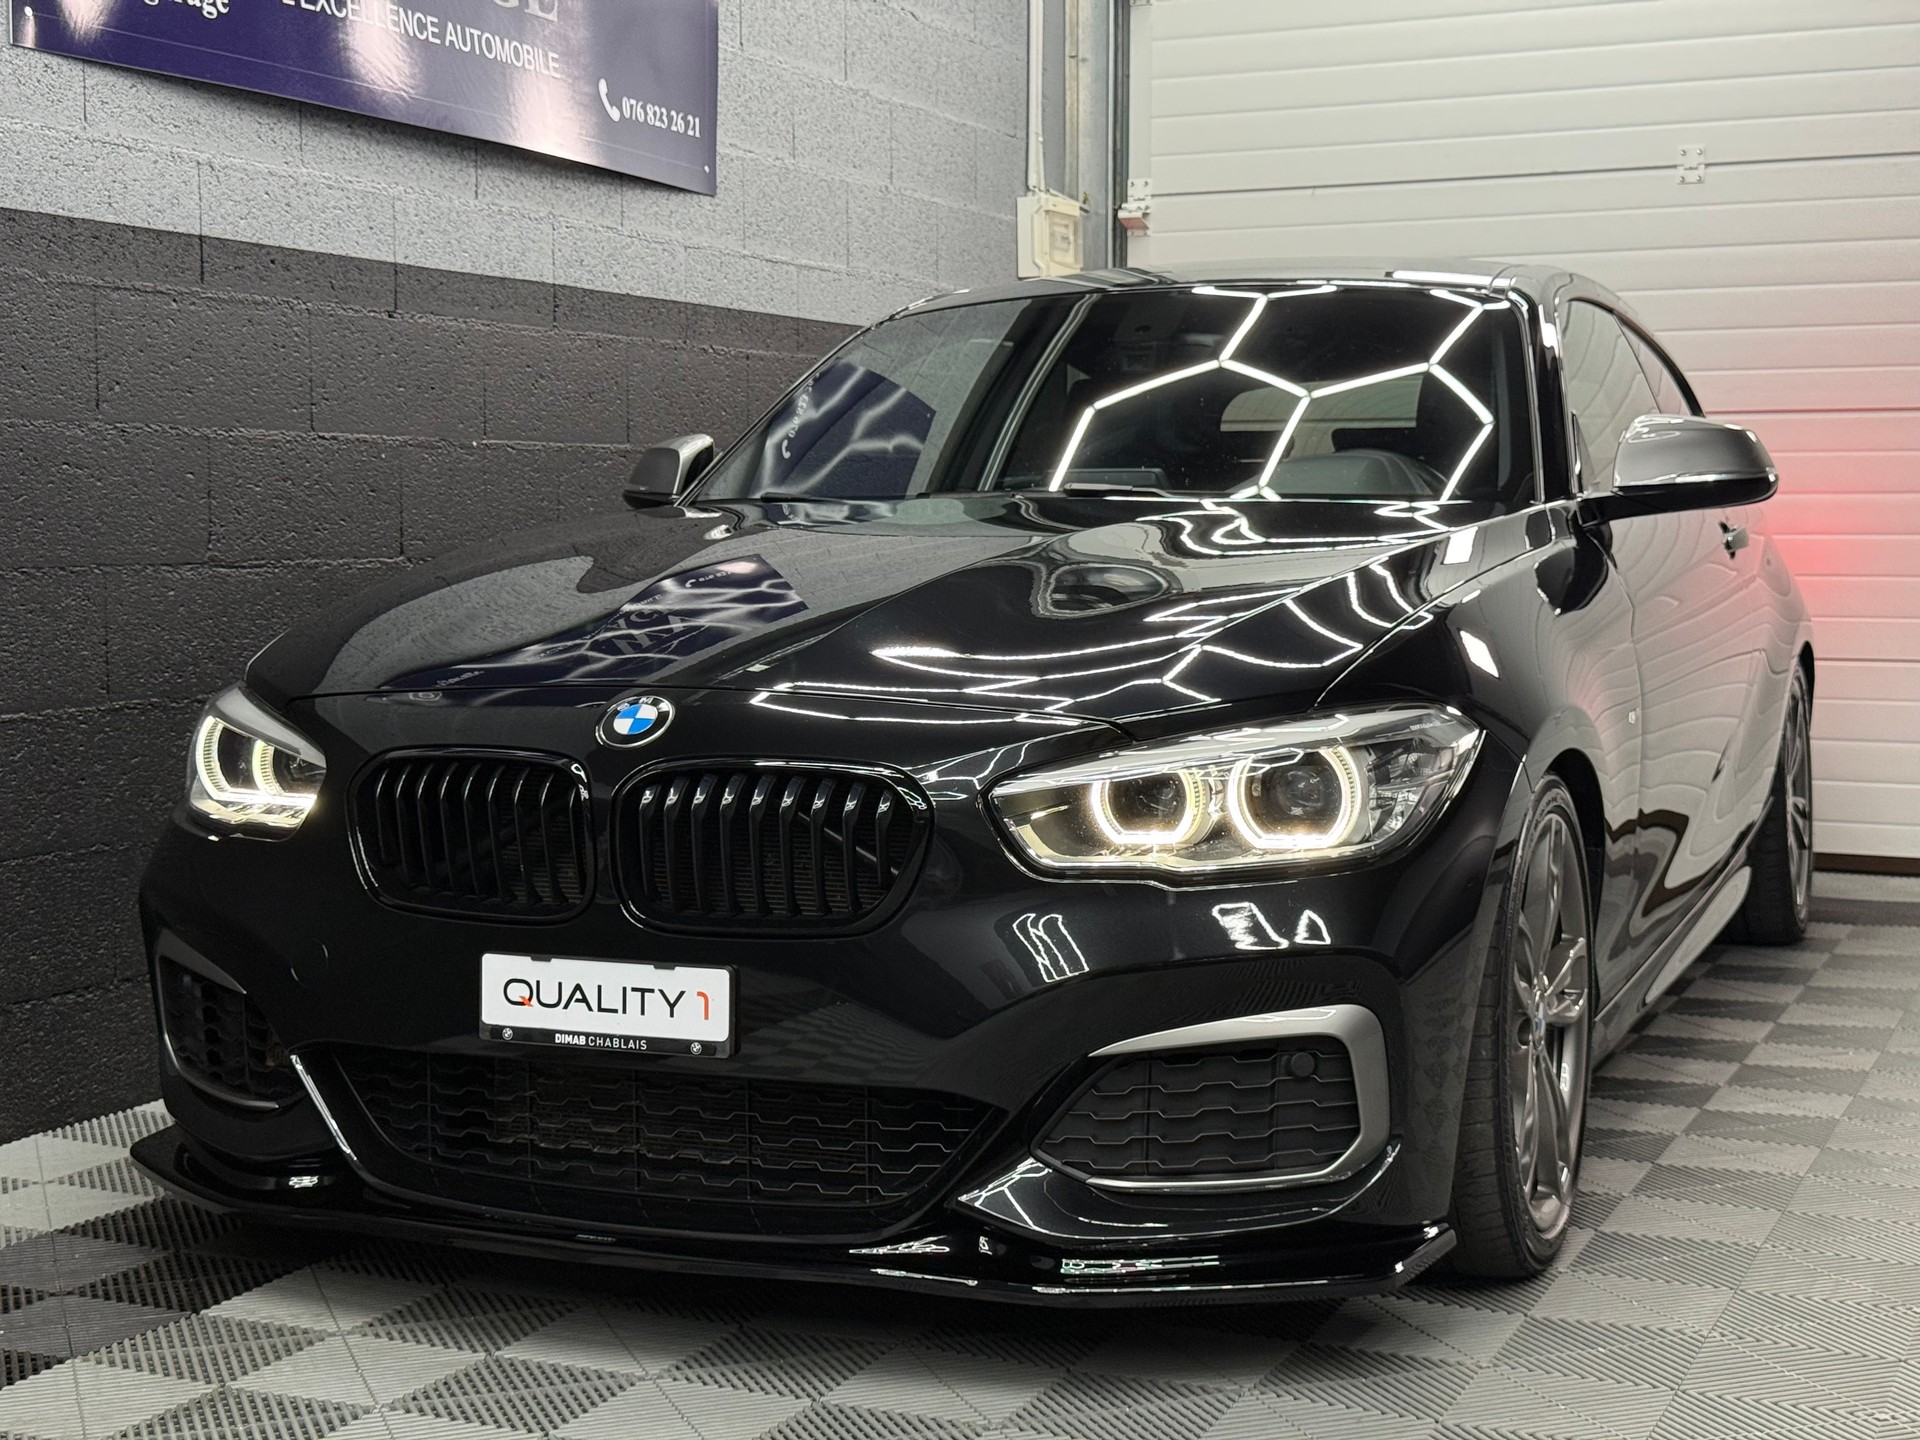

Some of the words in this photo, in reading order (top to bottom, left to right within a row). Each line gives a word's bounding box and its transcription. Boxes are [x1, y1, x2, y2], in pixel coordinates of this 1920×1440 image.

[445, 21, 562, 79] AUTOMOBILE
[621, 95, 645, 123] 076
[646, 102, 669, 129] 823
[670, 109, 685, 134] 26
[686, 114, 701, 138] 21
[554, 1033, 587, 1046] DIMAB
[588, 1035, 648, 1050] CHABLAIS
